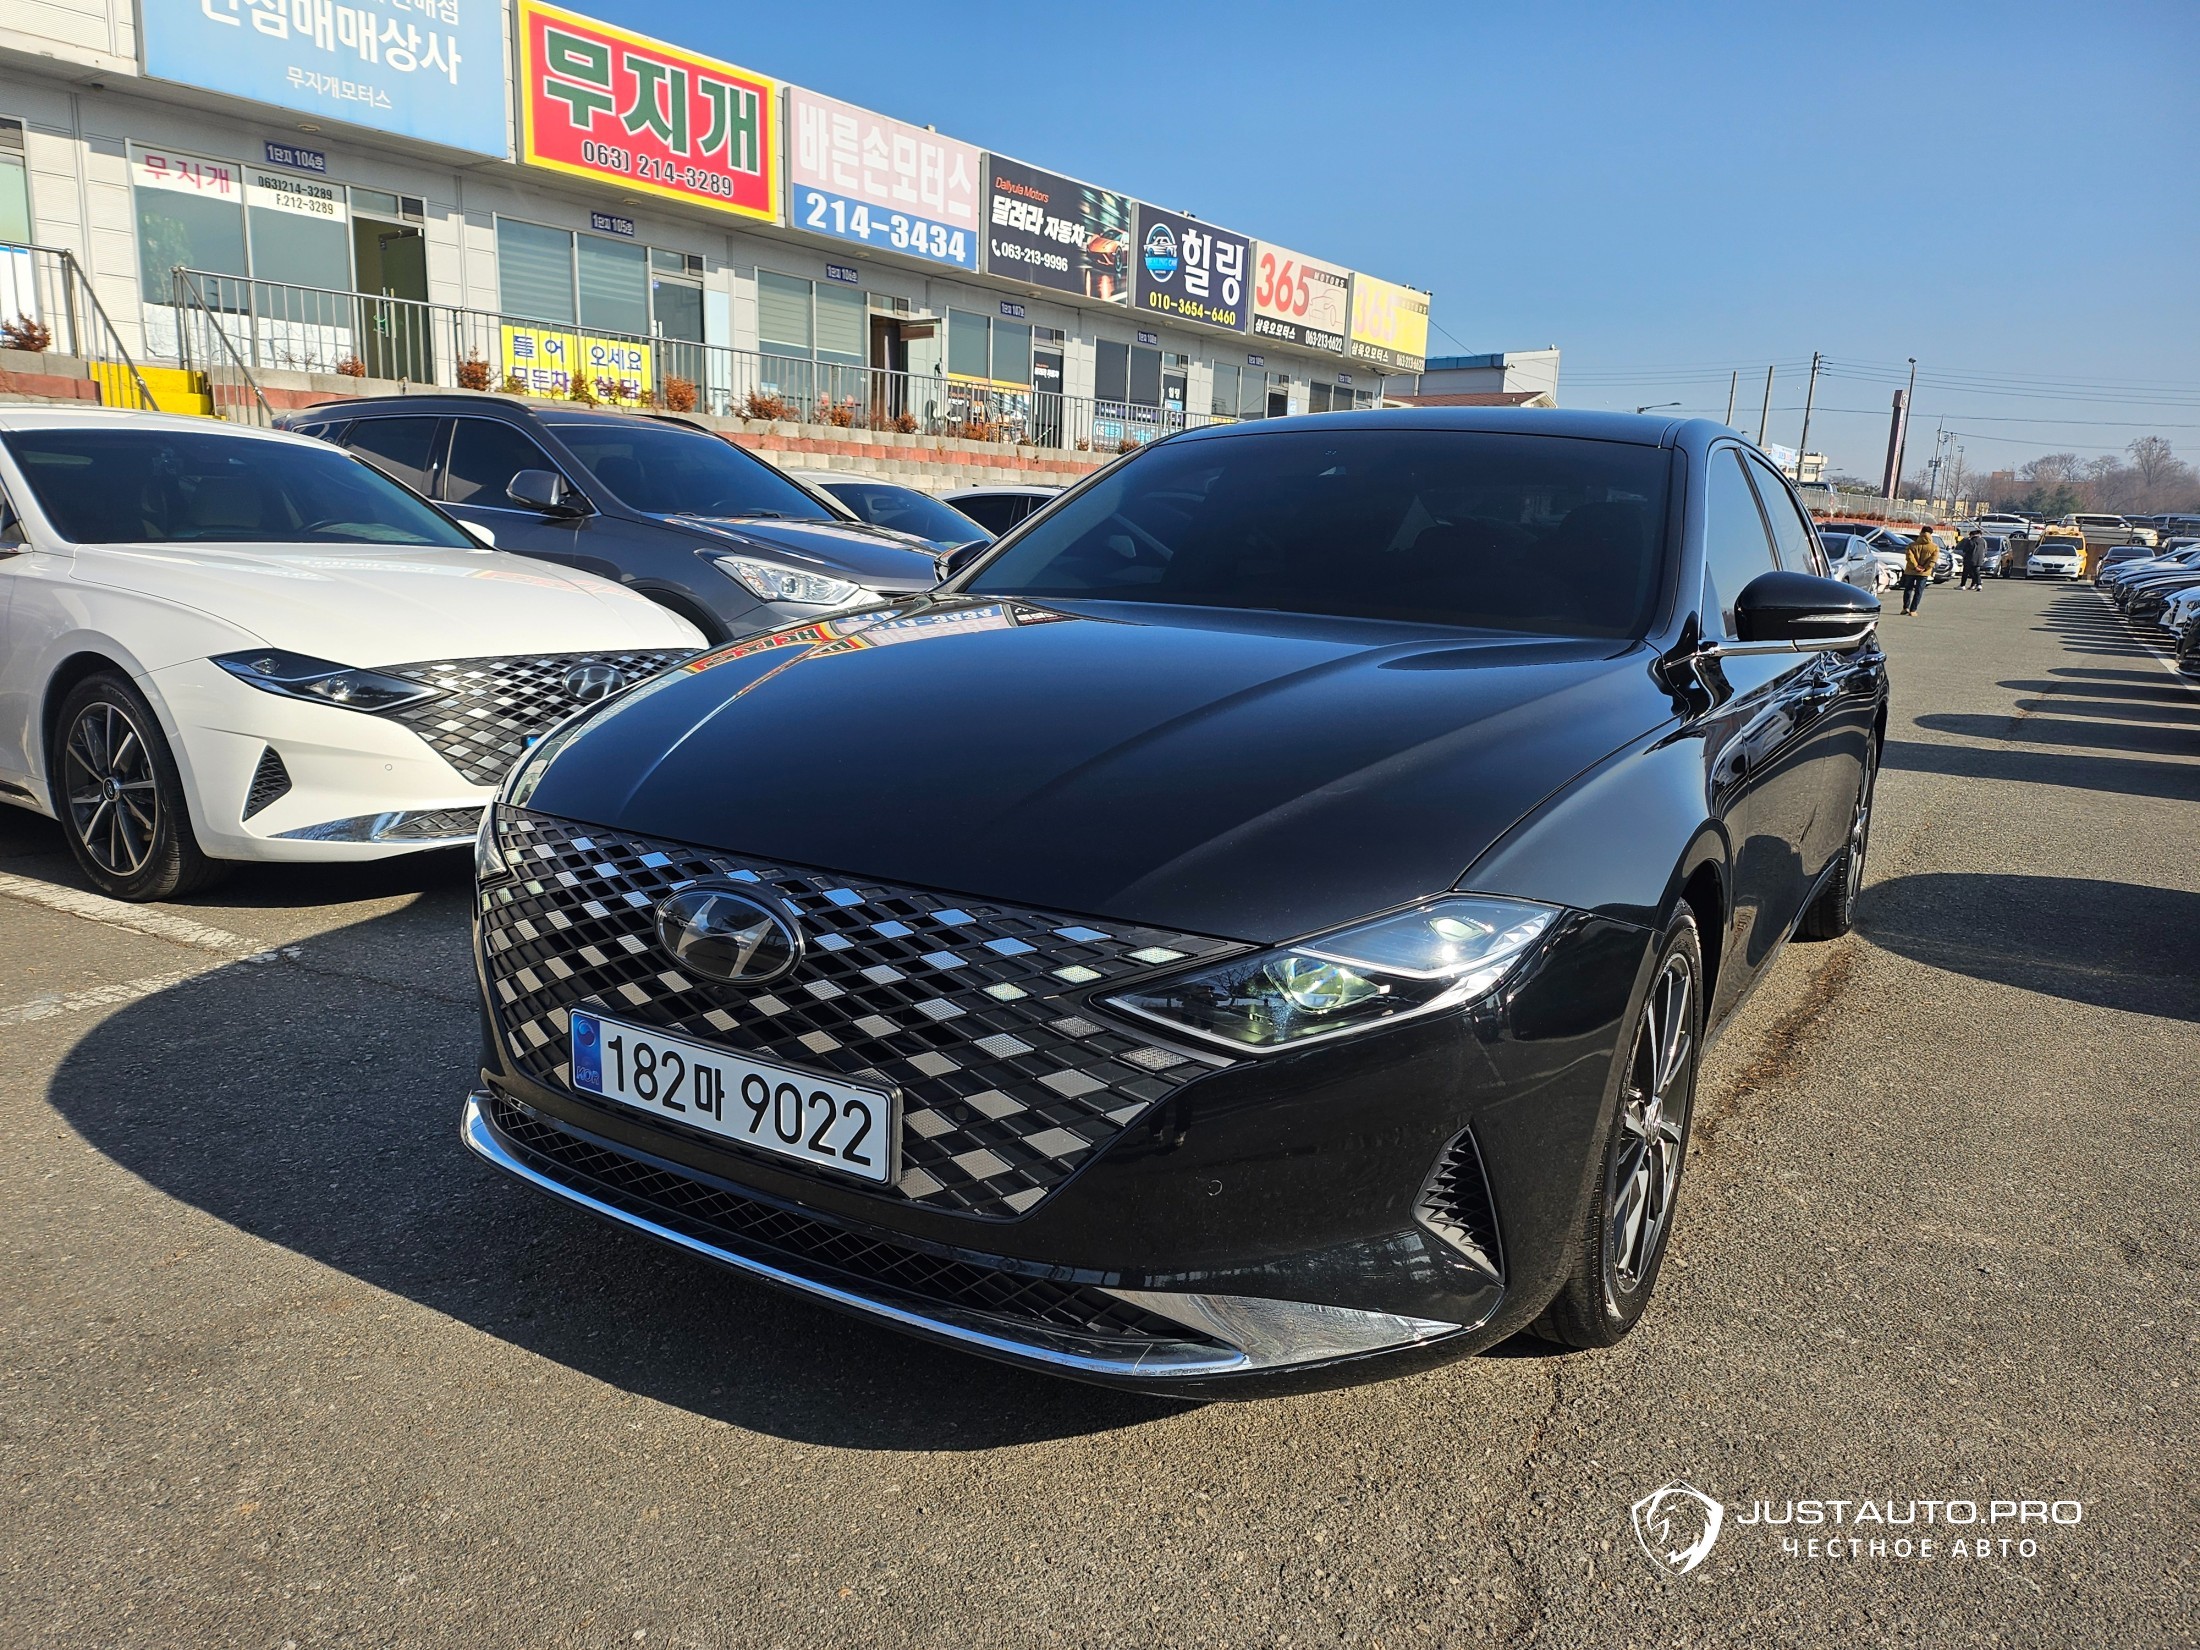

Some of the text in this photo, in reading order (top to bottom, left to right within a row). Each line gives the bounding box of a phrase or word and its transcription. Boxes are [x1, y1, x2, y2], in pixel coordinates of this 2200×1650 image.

[286, 66, 393, 109] 무지개모터스
[543, 25, 761, 176] 무지개
[144, 154, 231, 194] 무지개
[267, 144, 325, 171] 1단지 104호
[582, 139, 734, 198] 063) 214-3289
[798, 102, 972, 219] 바른손모터스
[1024, 185, 1050, 203] Motors
[805, 192, 967, 263] 214-3434
[991, 194, 1087, 248] 달려라 자동차
[1001, 241, 1069, 272] 063-213-9996
[1181, 228, 1245, 307] 힐링
[1256, 253, 1310, 317] 365
[1313, 271, 1345, 288] MOTORS
[1149, 291, 1236, 326] 010-3654-6460
[1255, 318, 1296, 340] 삼육오모터스
[1353, 283, 1397, 343] 365
[590, 345, 642, 371] 오세요
[1305, 329, 1343, 352] 063-213-6622
[576, 1065, 600, 1086] KOR
[607, 1034, 873, 1167] 182마 9022
